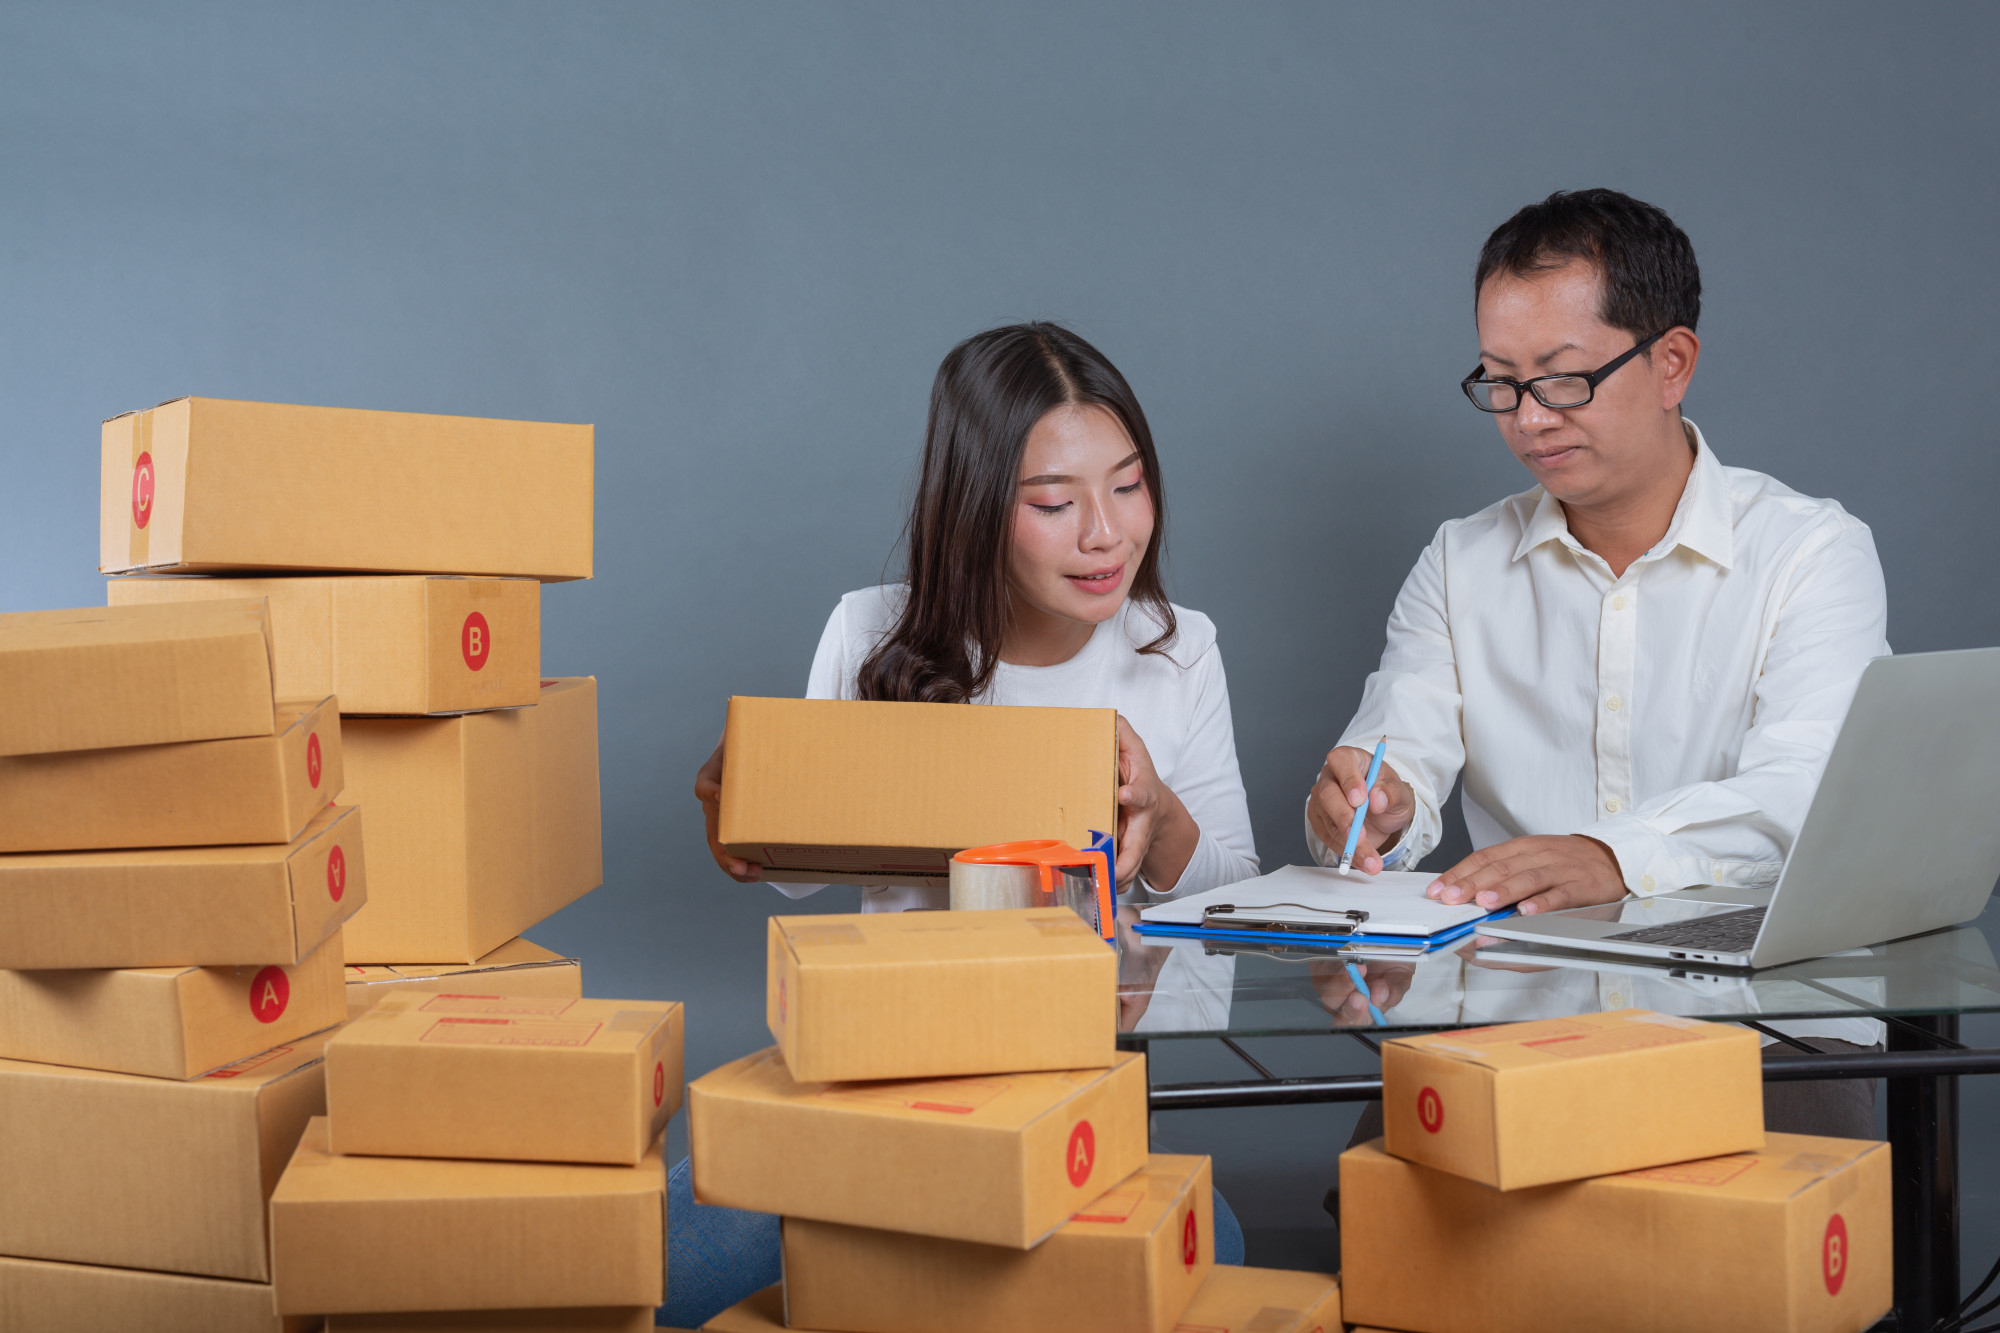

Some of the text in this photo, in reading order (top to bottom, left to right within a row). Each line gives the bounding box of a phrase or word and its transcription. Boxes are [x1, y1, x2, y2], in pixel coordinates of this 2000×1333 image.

[137, 467, 150, 512] C
[469, 626, 483, 657] B
[310, 747, 318, 776] A
[331, 859, 342, 887] A
[261, 980, 279, 1010] A
[1074, 1137, 1088, 1172] A
[1186, 1227, 1194, 1258] A
[1828, 1235, 1842, 1277] B
